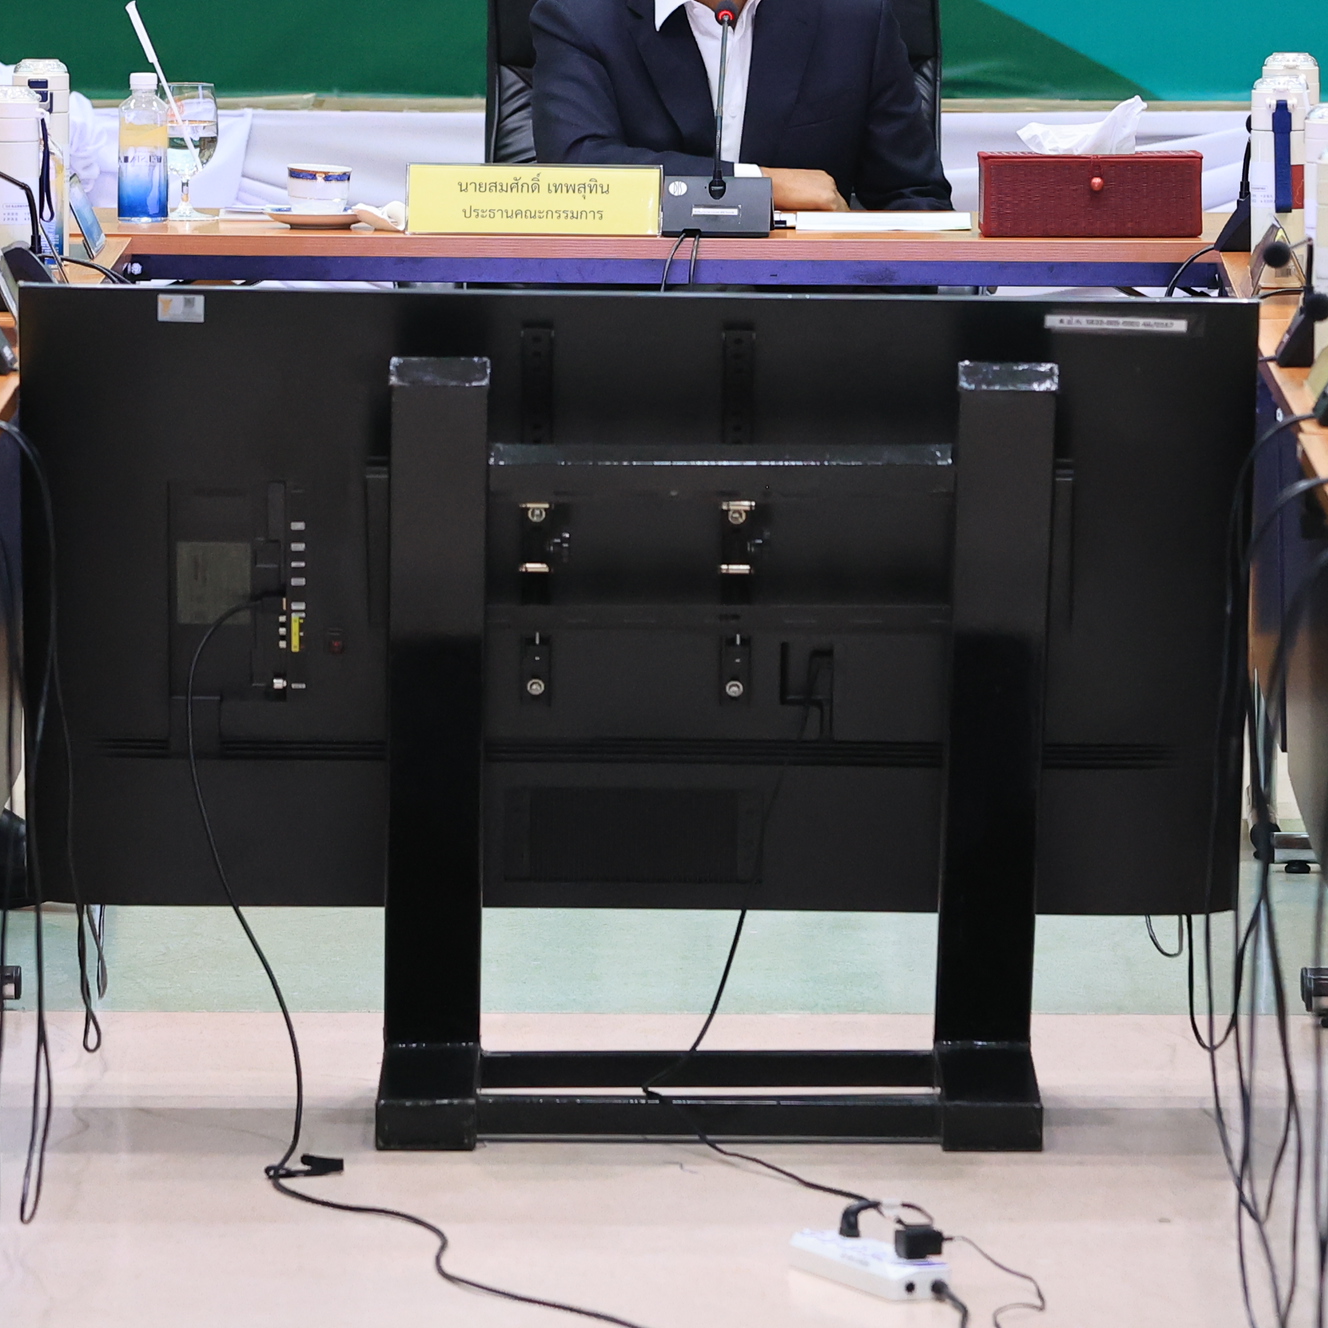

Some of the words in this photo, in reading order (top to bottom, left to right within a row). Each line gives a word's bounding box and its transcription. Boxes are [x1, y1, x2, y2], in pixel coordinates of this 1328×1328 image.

[457, 172, 541, 194] นายสมศักดิ์
[547, 178, 610, 200] เทพสุทิน
[461, 205, 604, 221] ประธานคณะกรรมการ
